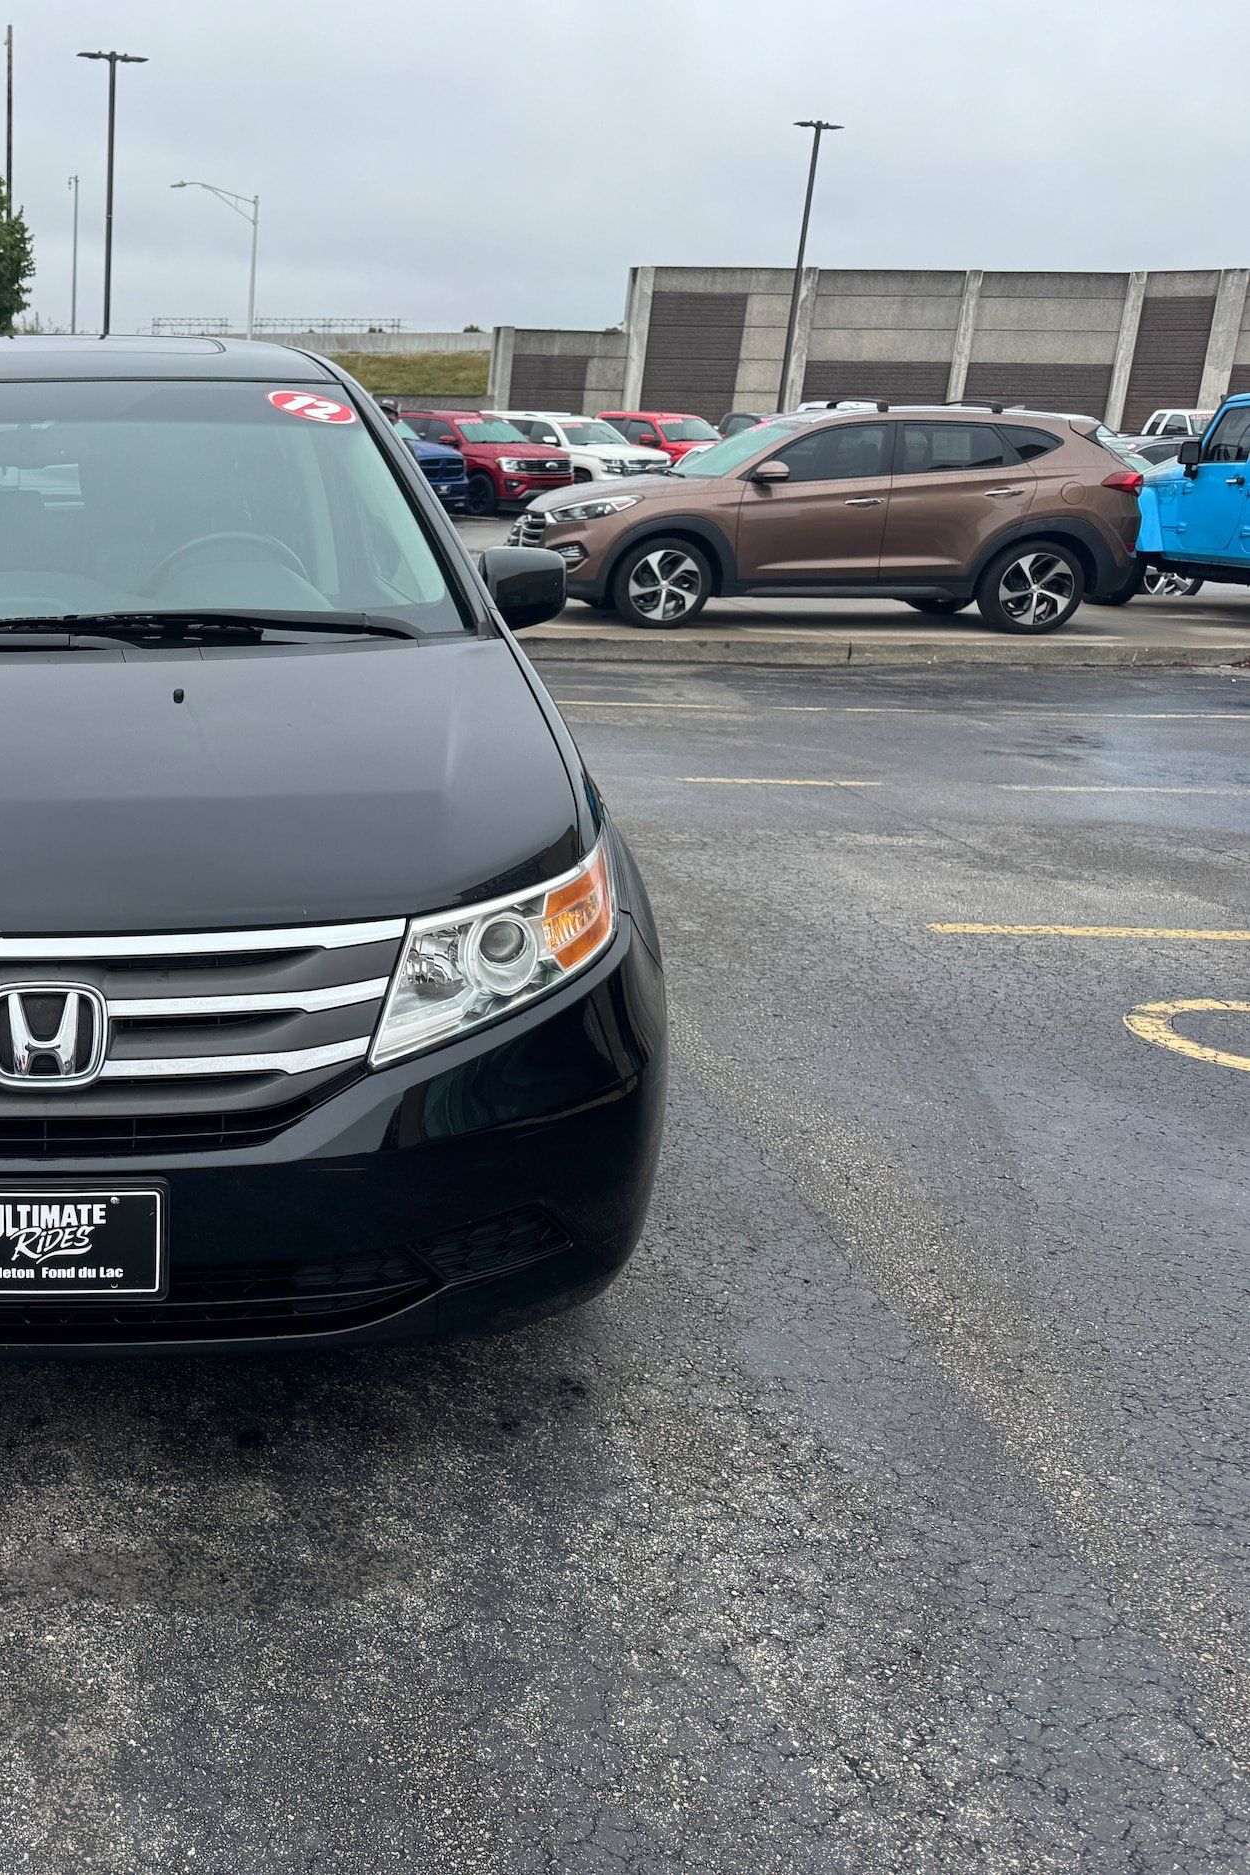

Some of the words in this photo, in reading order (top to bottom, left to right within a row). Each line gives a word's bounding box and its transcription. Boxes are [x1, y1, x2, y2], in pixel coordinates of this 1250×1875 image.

[281, 395, 342, 420] 12
[41, 1266, 76, 1279] Fond
[77, 1266, 97, 1279] du
[99, 1266, 124, 1279] Lac
